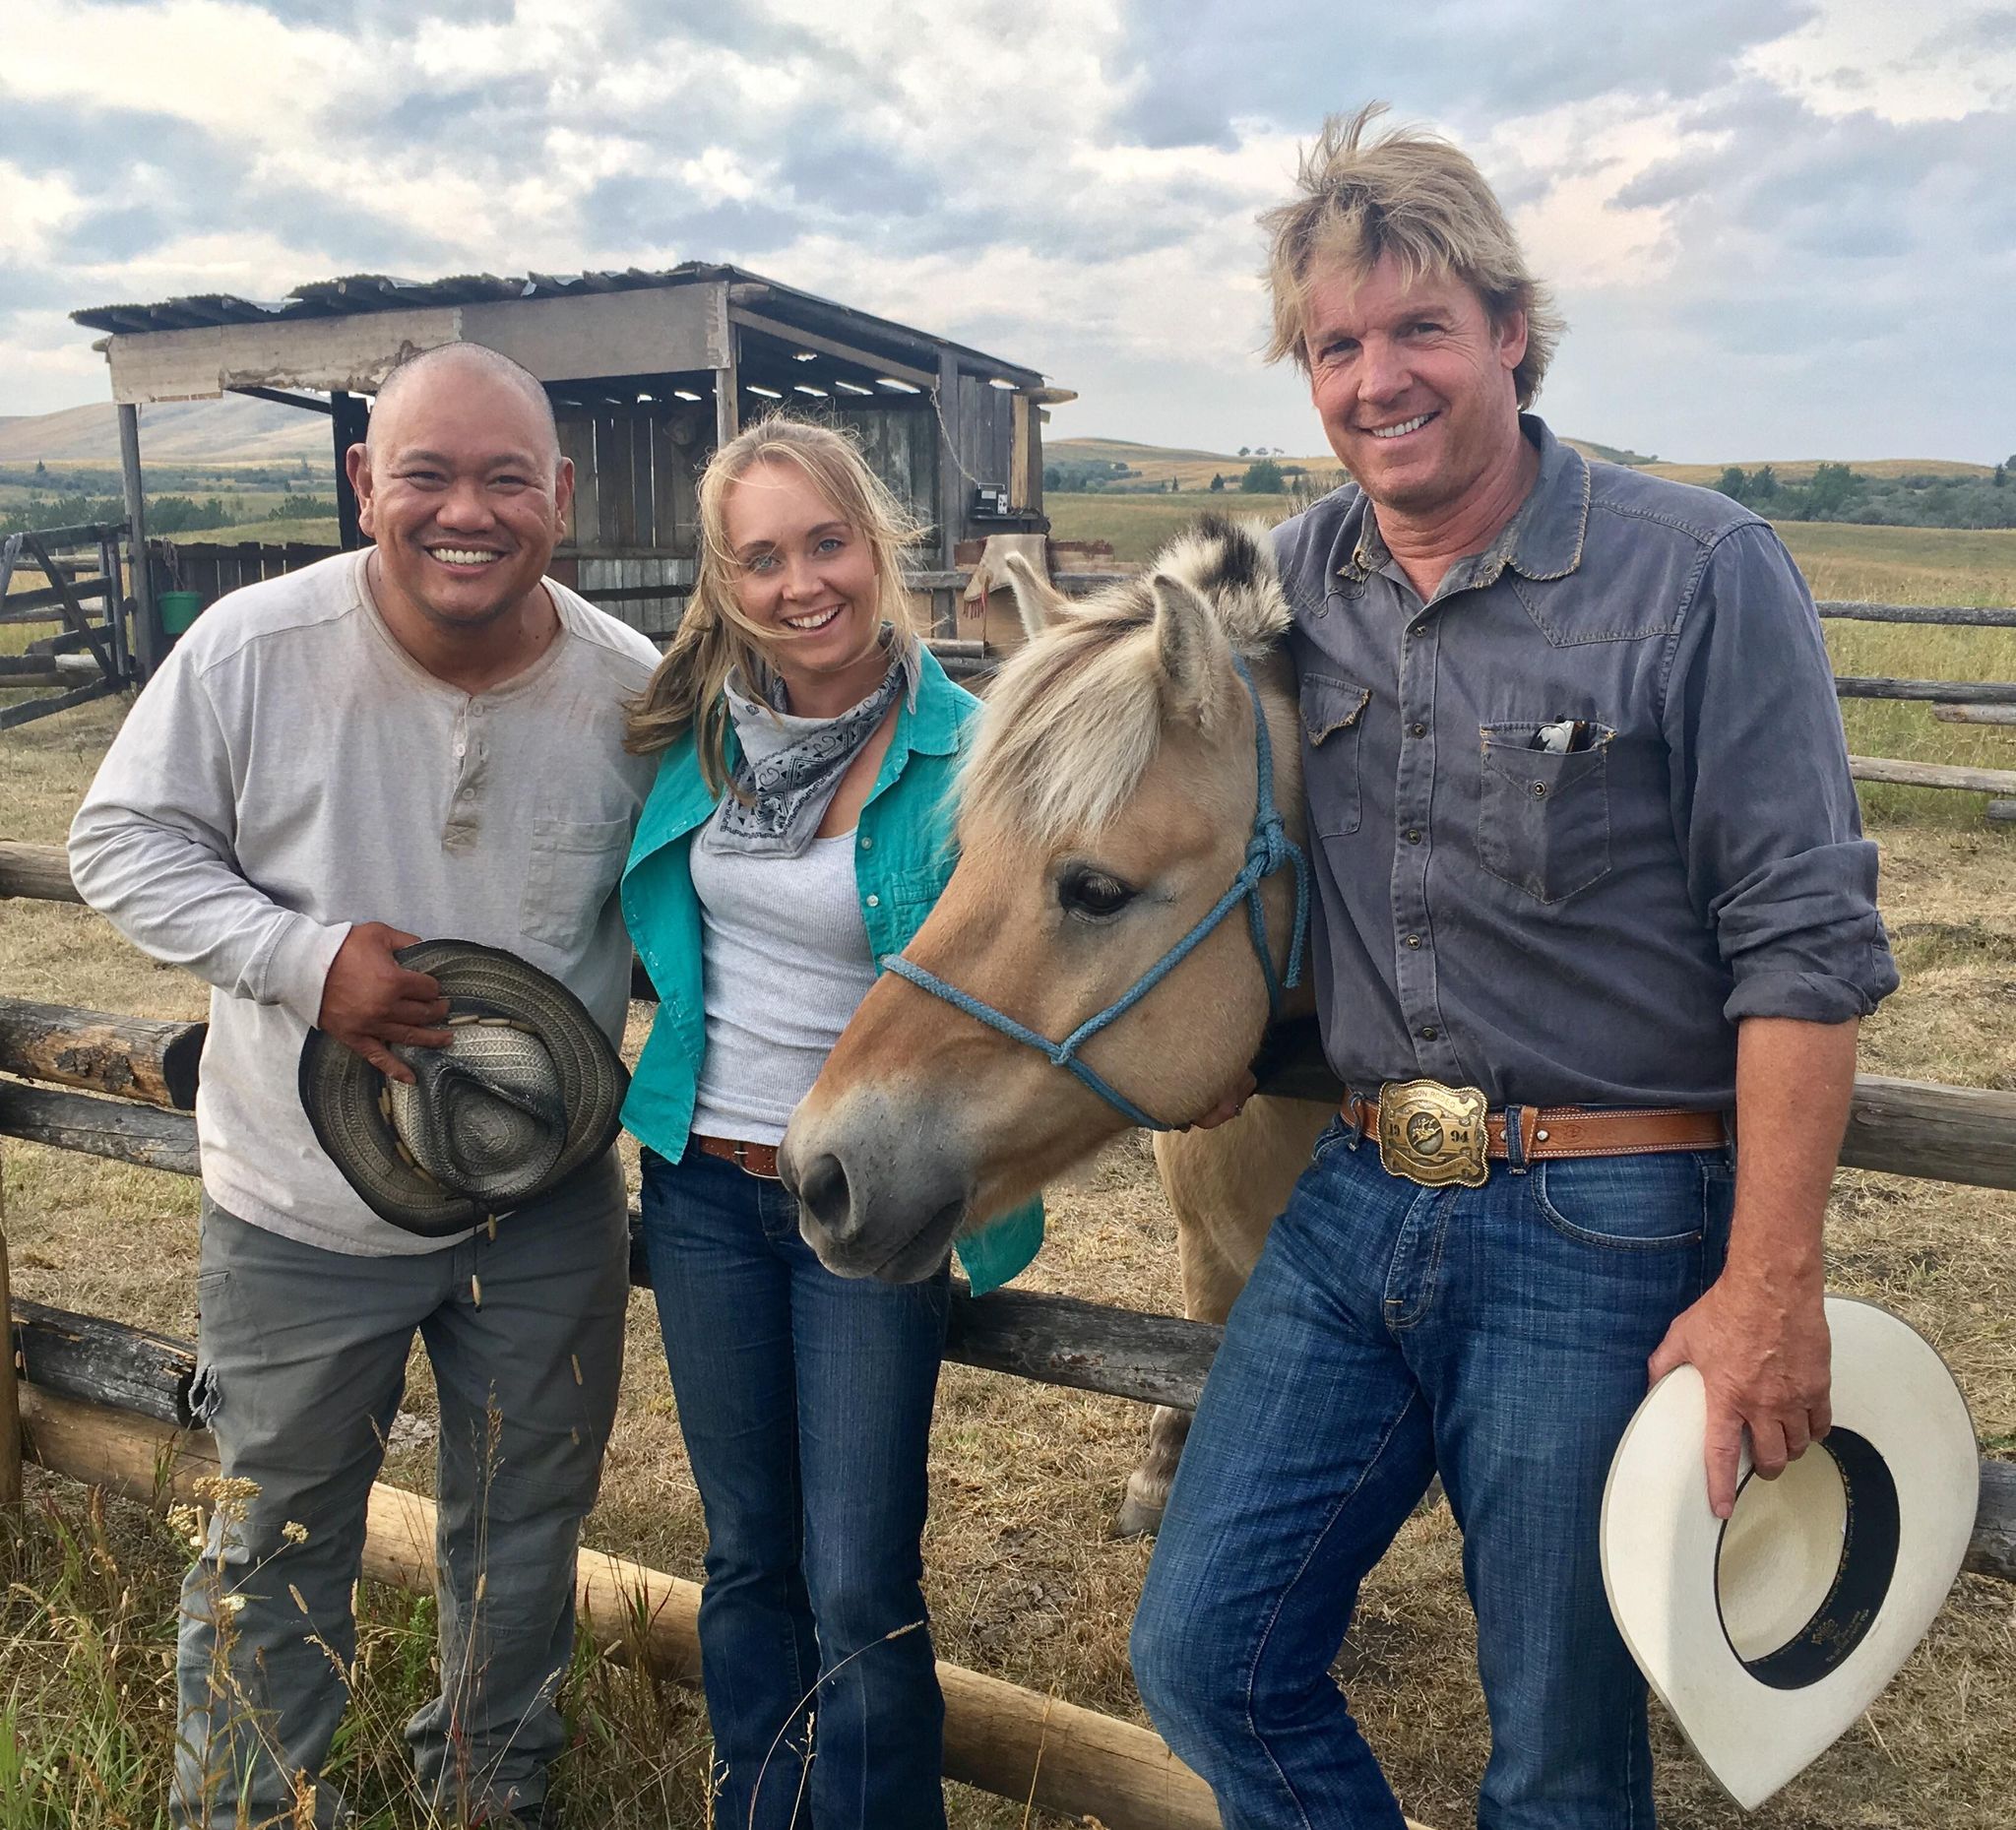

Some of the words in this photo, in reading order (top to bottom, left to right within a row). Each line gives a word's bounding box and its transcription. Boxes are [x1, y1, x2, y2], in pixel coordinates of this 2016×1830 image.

[1429, 1091, 1456, 1108] RODEO
[1389, 1123, 1401, 1137] 19
[1450, 1130, 1470, 1143] 94
